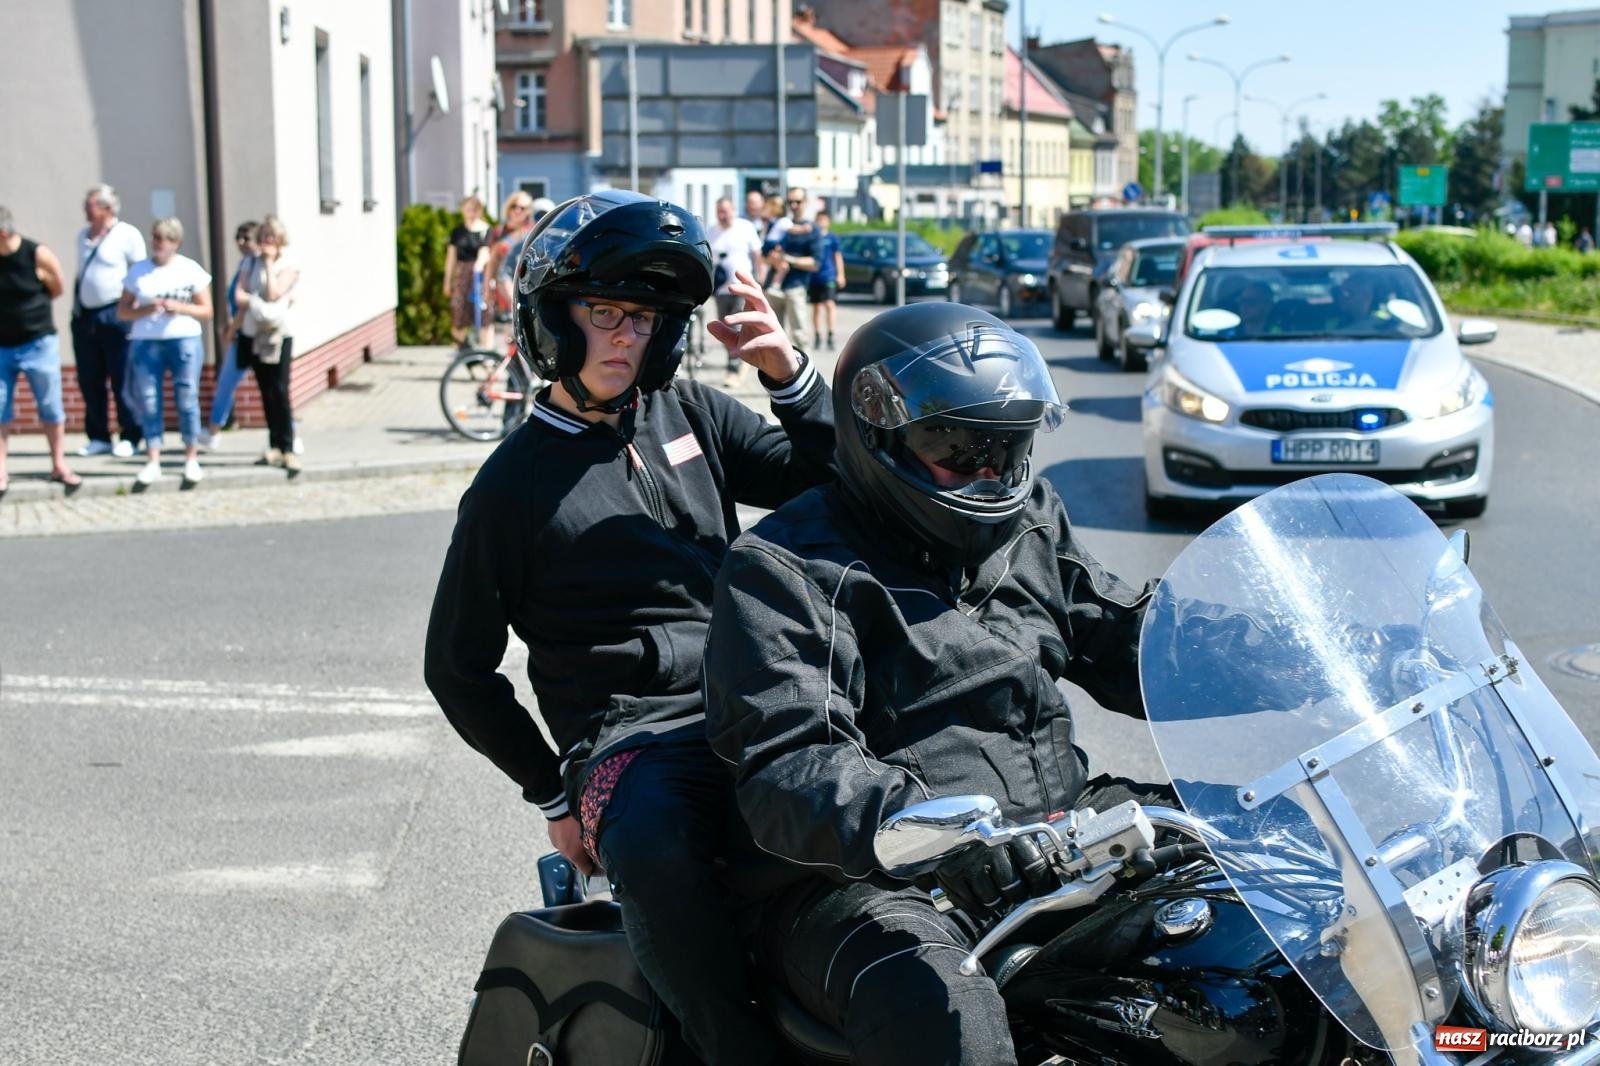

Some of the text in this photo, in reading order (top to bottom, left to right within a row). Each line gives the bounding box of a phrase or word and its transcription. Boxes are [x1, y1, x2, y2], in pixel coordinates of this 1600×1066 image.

[1265, 372, 1377, 389] POLICJA
[1285, 440, 1376, 461] HPP R014
